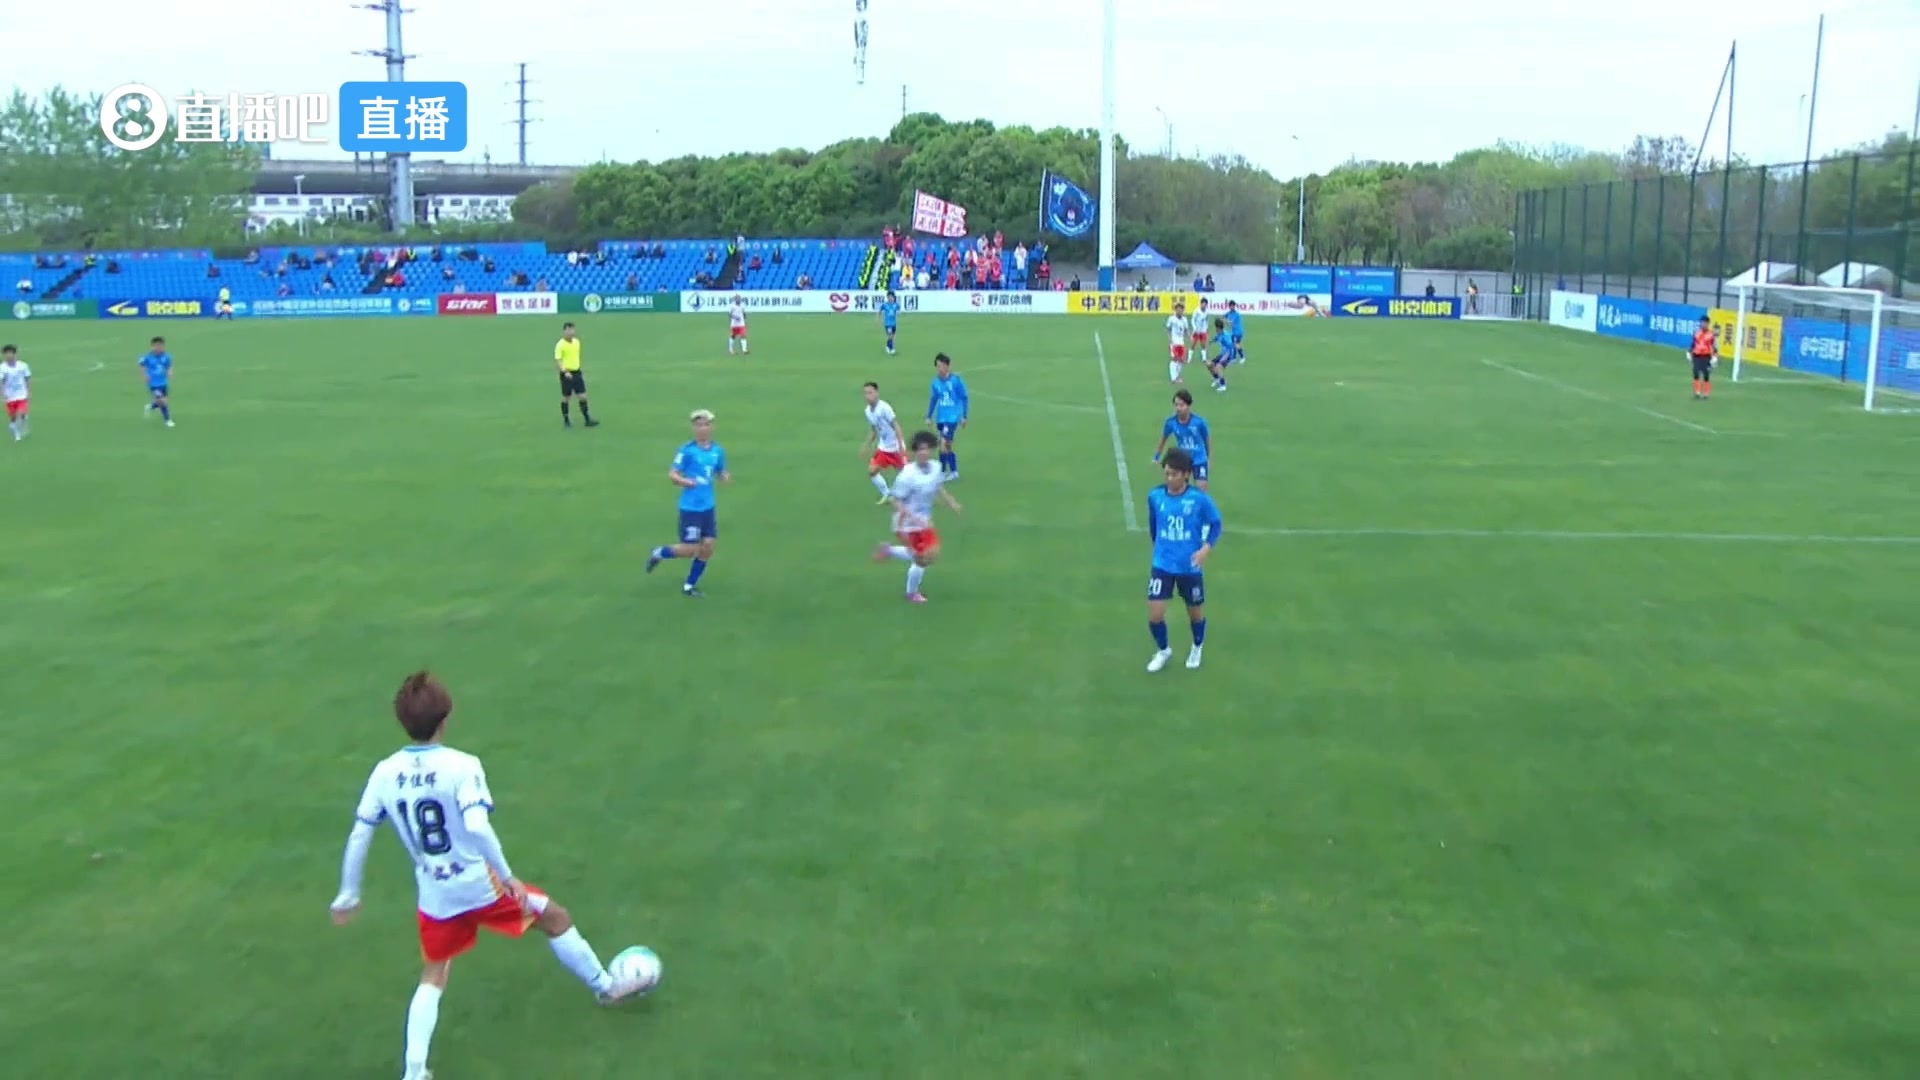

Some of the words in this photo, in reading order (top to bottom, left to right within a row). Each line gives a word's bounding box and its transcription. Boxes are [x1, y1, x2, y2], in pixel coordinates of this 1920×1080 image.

[1081, 296, 1160, 312] 中吴江南春
[1167, 515, 1185, 530] 20
[397, 797, 452, 857] 18
